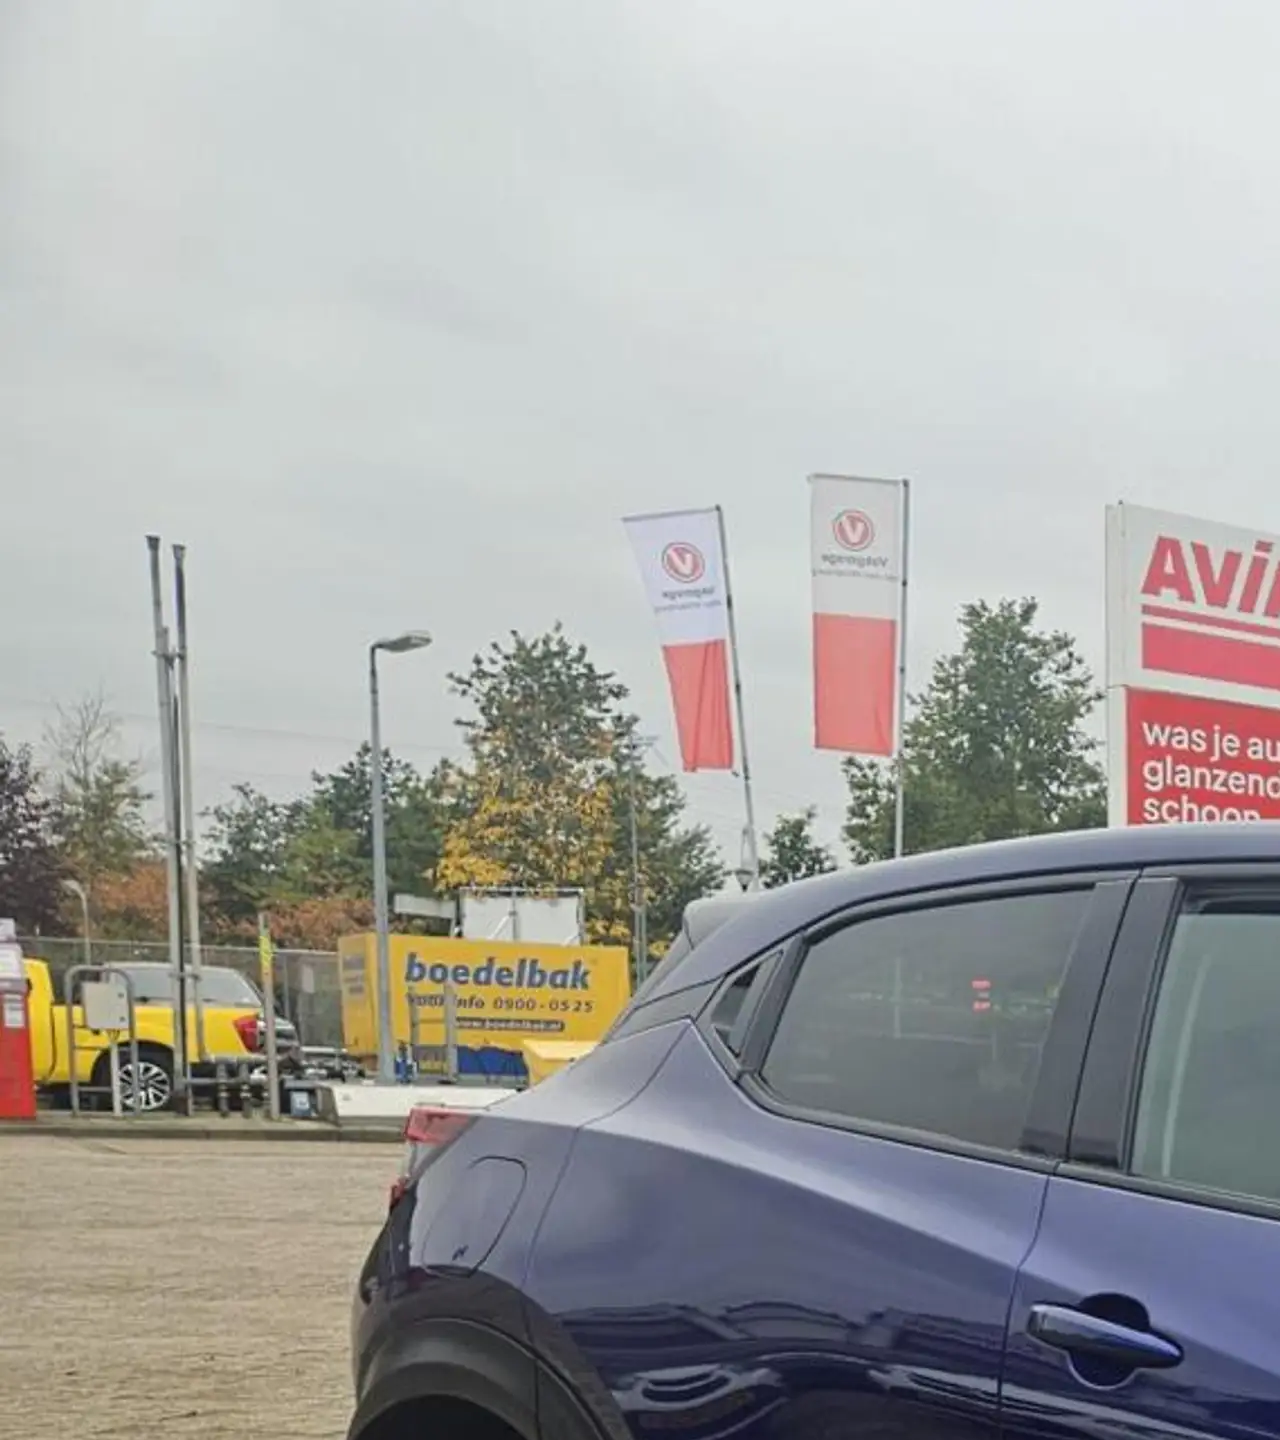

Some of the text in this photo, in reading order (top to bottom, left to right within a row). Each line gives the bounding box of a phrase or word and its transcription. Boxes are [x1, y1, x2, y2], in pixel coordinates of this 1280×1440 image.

[1142, 721, 1207, 751] was
[1211, 725, 1240, 761] je
[405, 951, 591, 989] boedelbak
